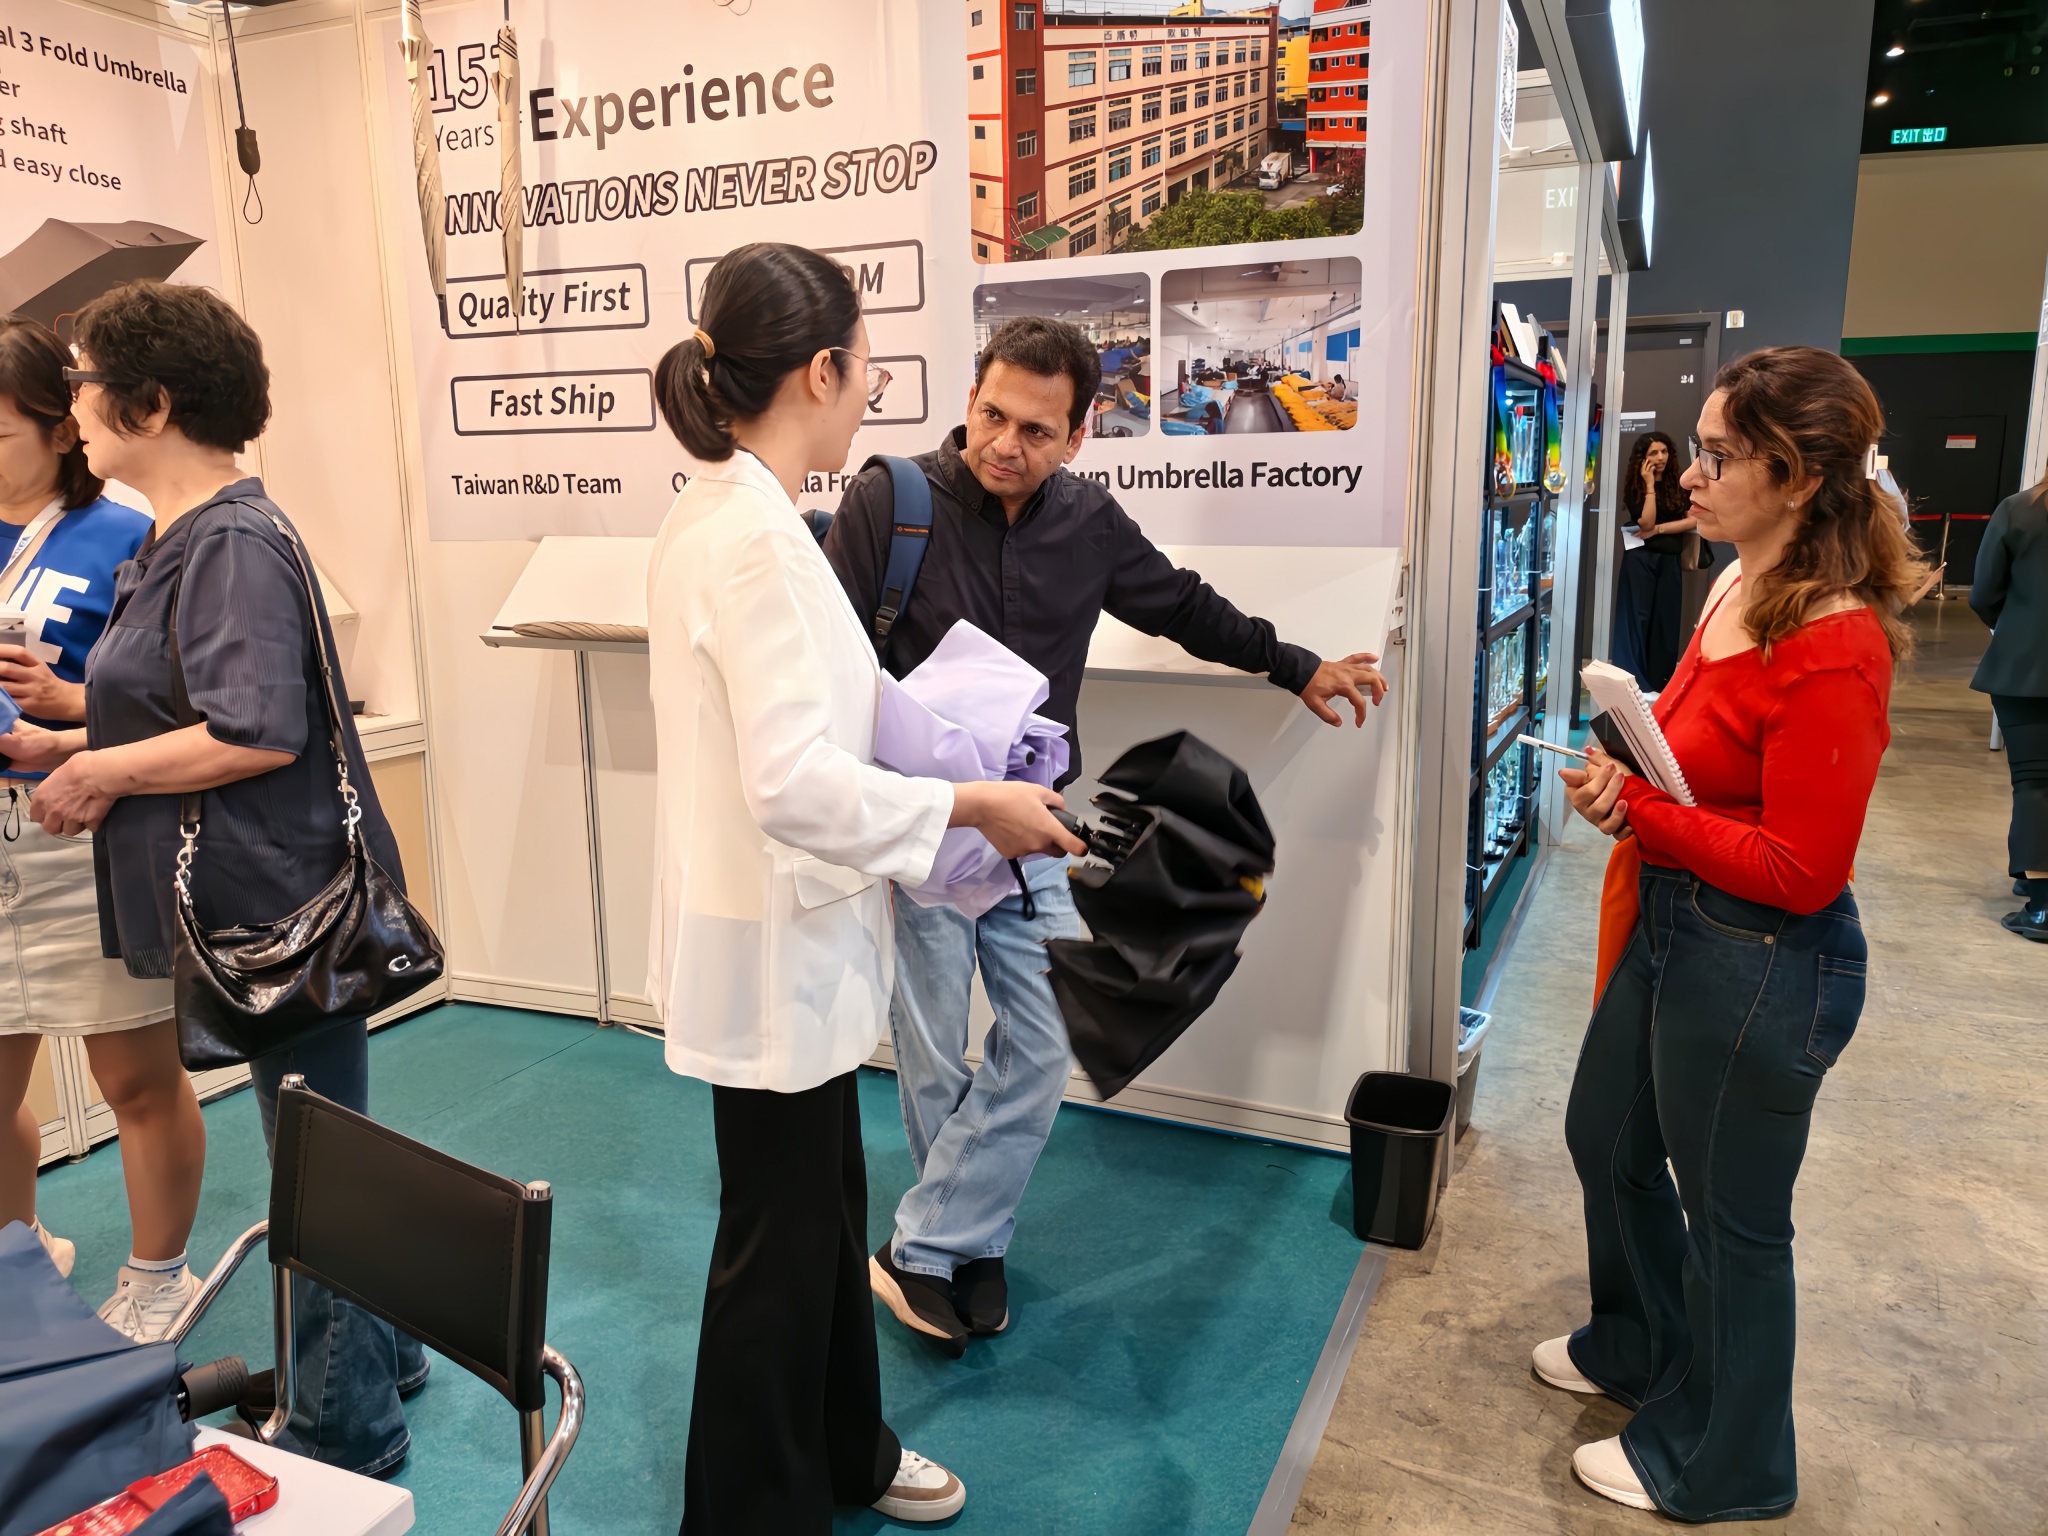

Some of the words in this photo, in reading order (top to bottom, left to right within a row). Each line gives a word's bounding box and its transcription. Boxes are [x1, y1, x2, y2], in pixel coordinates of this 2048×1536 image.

[20, 31, 34, 53] 3
[39, 36, 88, 68] Fold
[93, 51, 187, 94] Umbrella
[435, 124, 495, 152] Years
[529, 62, 835, 151] Experience
[10, 116, 68, 145] shaft
[1893, 128, 1921, 144] EXIT
[1922, 127, 1946, 143] 出口
[13, 157, 63, 183] easy
[69, 164, 122, 191] close
[684, 155, 817, 213] NEVER
[821, 140, 938, 200] STOP
[458, 286, 555, 328] Quaity
[563, 281, 631, 315] First
[1680, 374, 1694, 384] 24
[490, 388, 543, 418] Fast
[550, 383, 615, 422] Ship
[451, 473, 519, 495] Taiwan
[522, 473, 560, 495] R&D
[563, 473, 622, 494] Team
[1117, 460, 1244, 490] Umbrella
[1250, 461, 1363, 494] Factory
